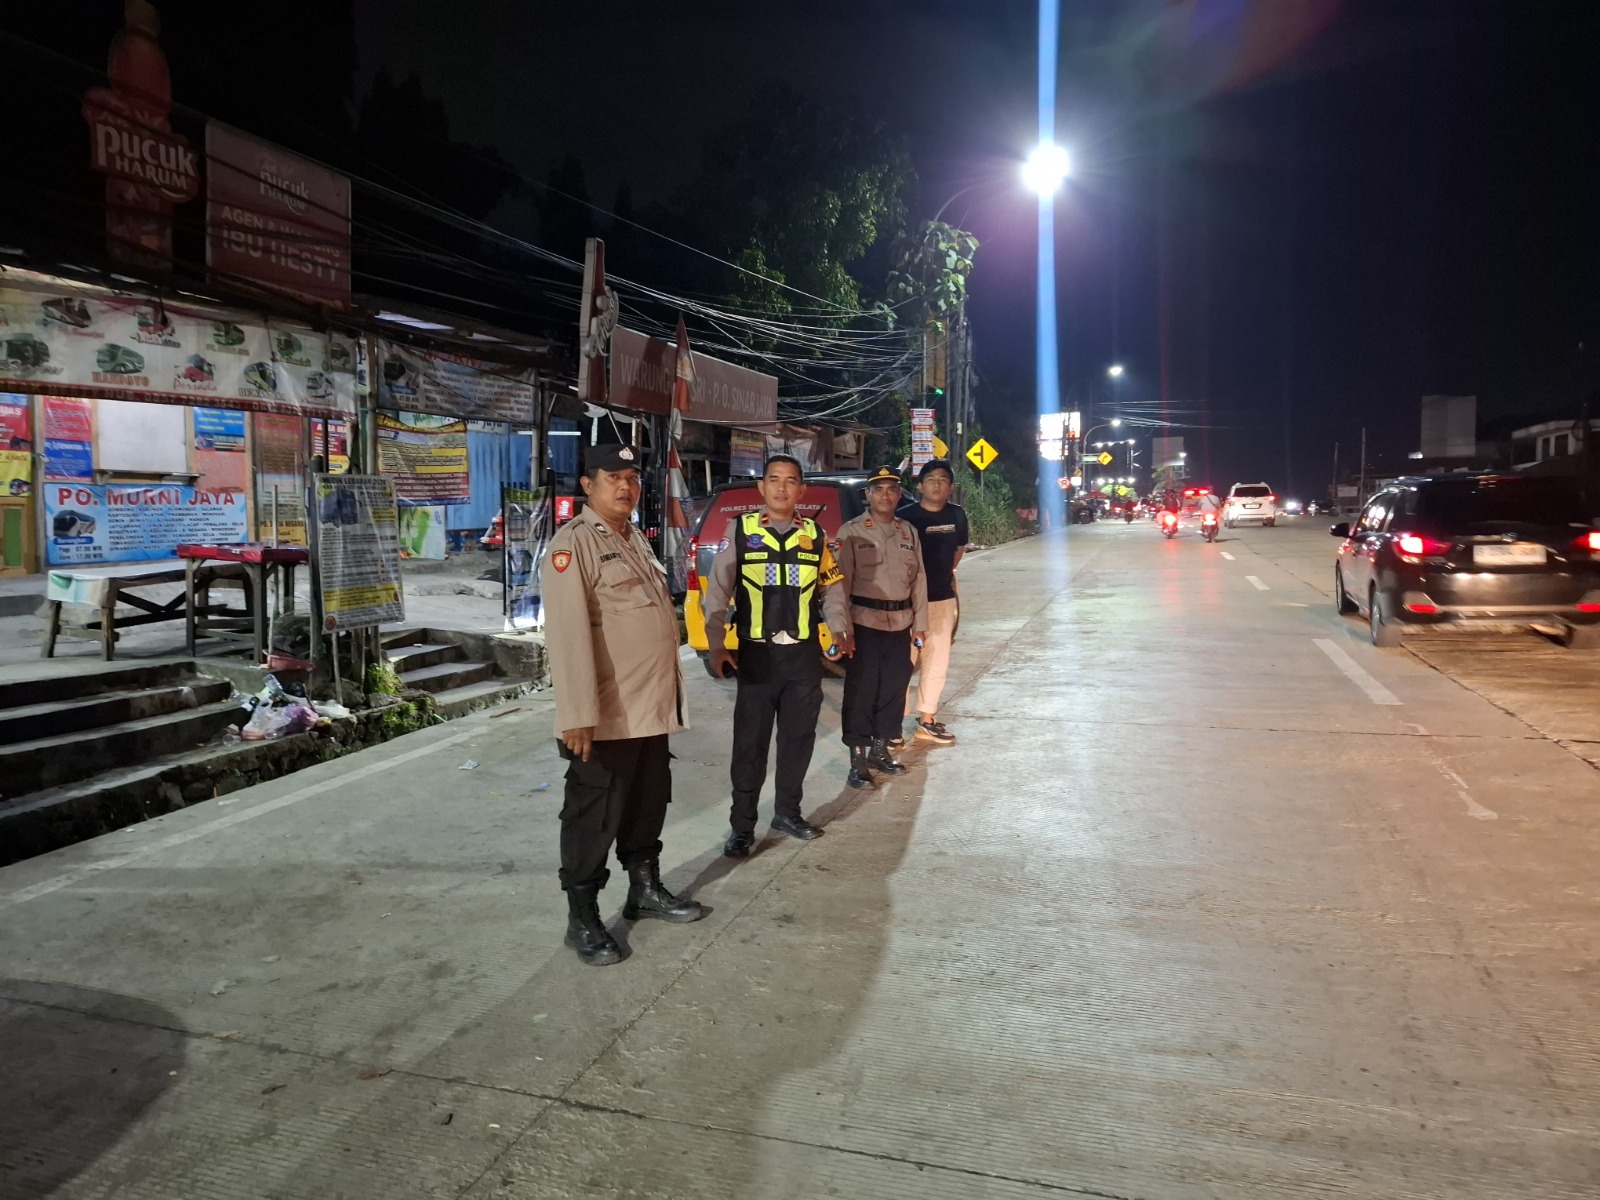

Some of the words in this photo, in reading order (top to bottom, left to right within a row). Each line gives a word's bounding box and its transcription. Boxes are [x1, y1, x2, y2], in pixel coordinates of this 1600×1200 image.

[115, 155, 187, 190] HARUM
[221, 205, 263, 229] AGEN
[620, 354, 671, 395] WARUNG
[732, 387, 755, 414] SINAR
[755, 392, 772, 418] JAYA
[59, 487, 98, 506] PO.
[107, 488, 180, 506] MURNI
[188, 490, 236, 506] JAYA
[720, 504, 747, 512] POLRES
